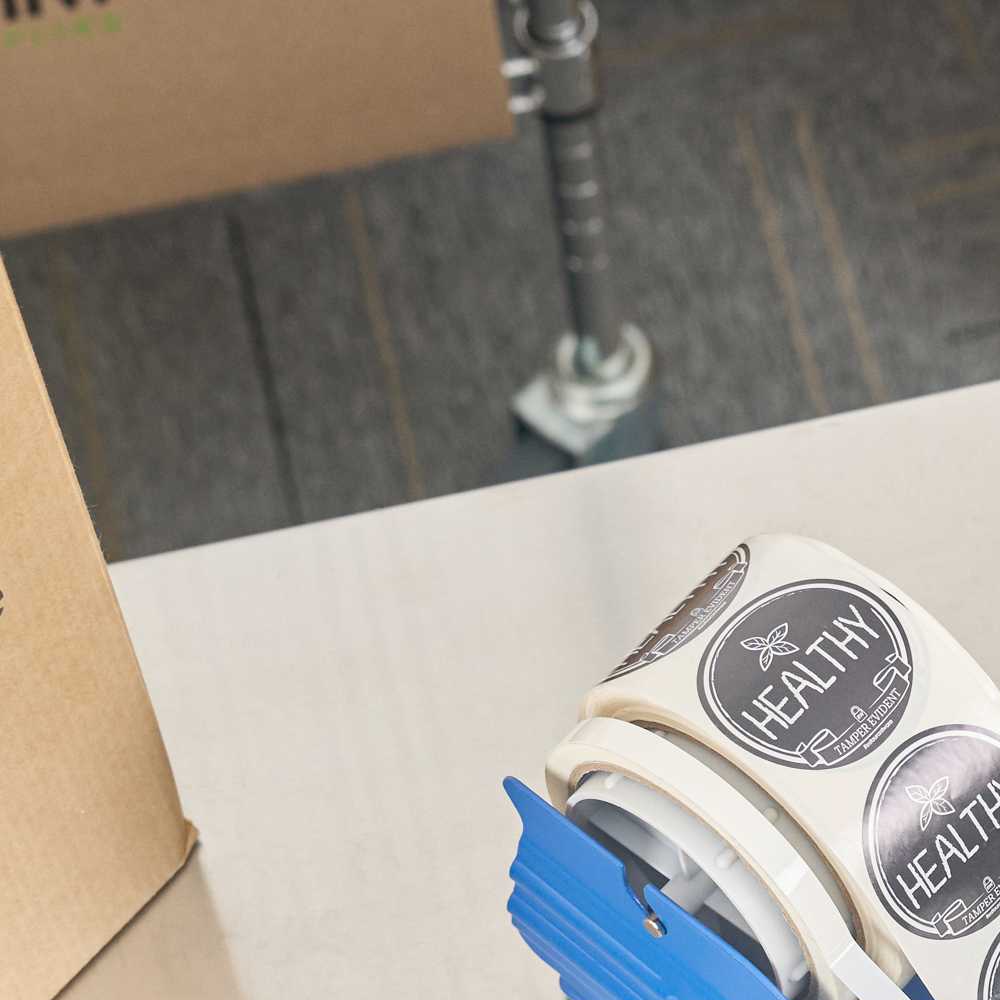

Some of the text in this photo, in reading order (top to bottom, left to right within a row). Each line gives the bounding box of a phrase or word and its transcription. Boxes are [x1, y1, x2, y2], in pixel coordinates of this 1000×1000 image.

[741, 604, 880, 740] HEALTHY
[833, 688, 901, 755] TAMPER EVIDENT
[962, 894, 996, 925] TAMPER
